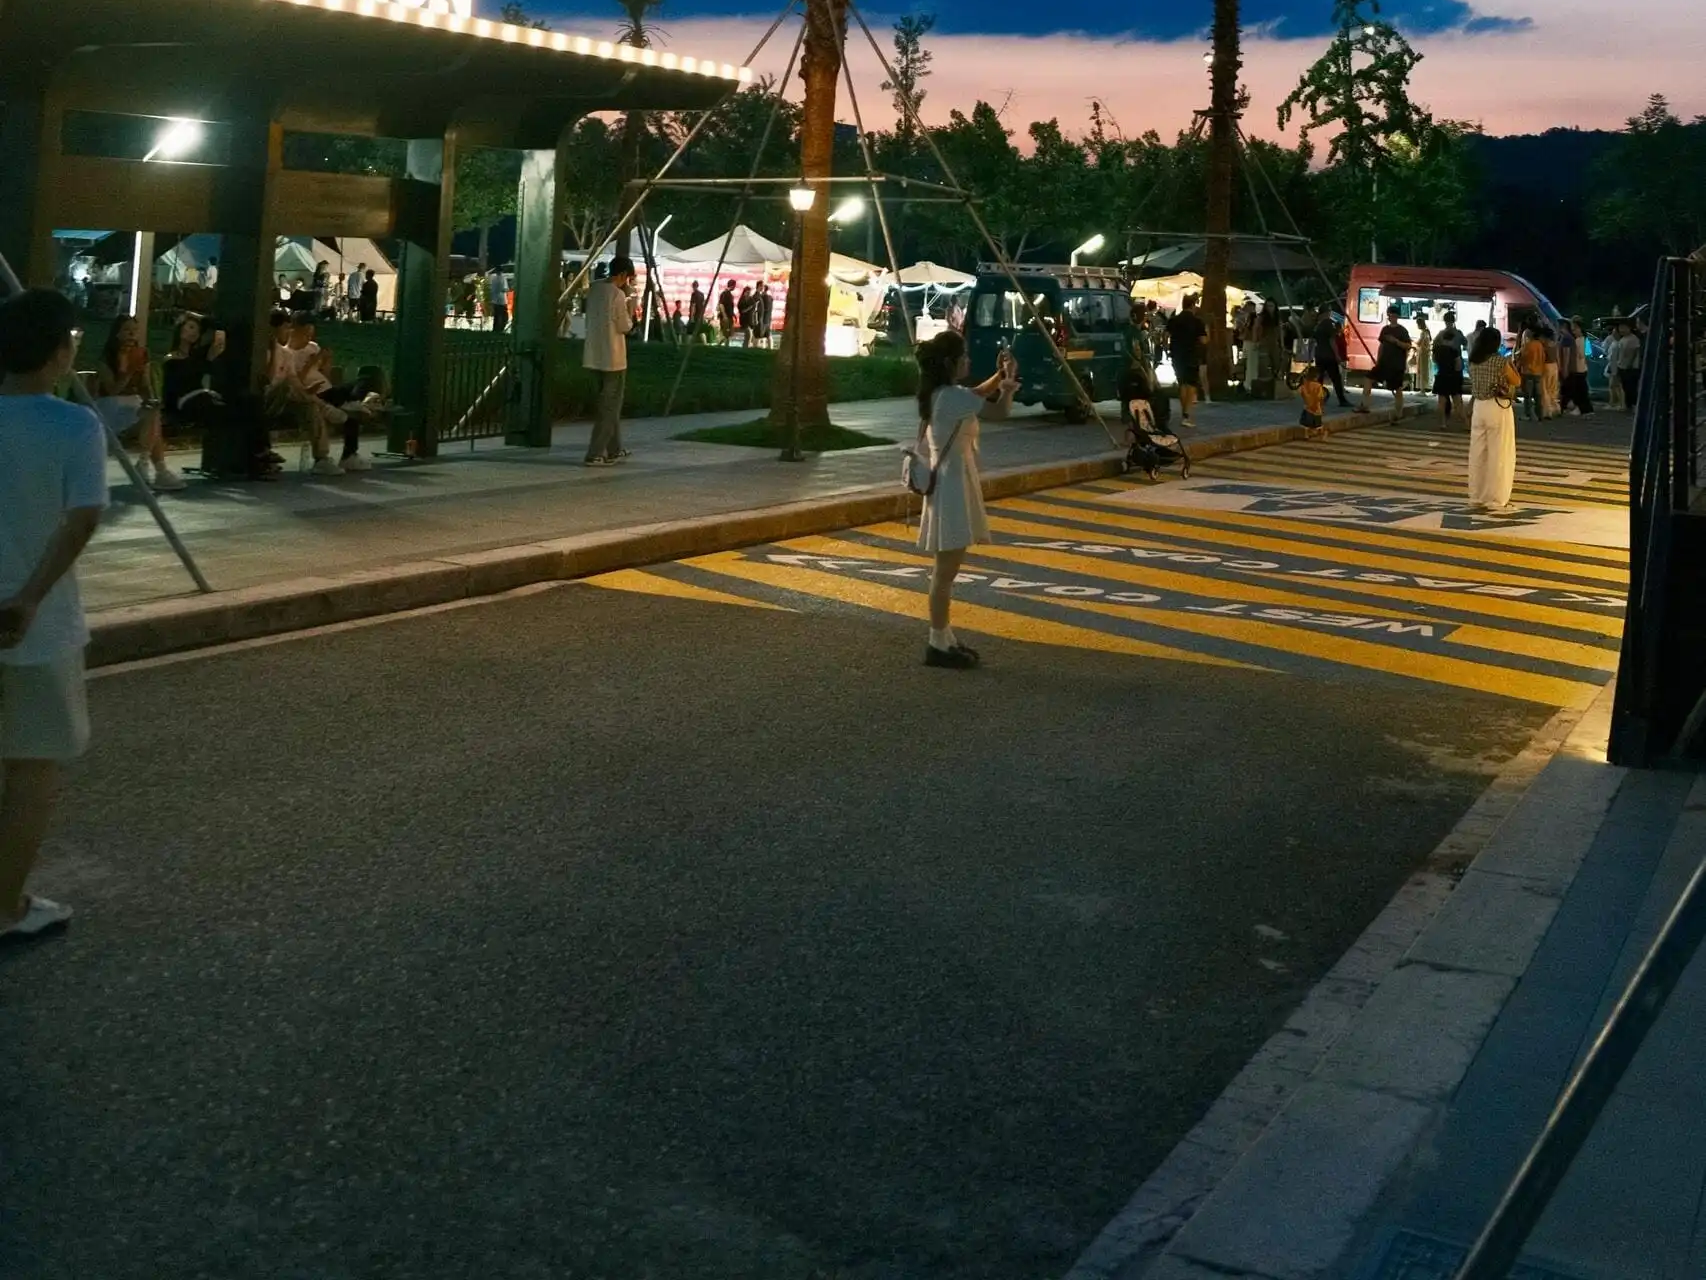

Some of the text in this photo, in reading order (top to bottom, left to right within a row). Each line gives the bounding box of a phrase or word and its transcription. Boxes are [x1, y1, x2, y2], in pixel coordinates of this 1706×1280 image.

[1010, 541, 1539, 596] EAST COAST
[1186, 604, 1434, 637] WEST
